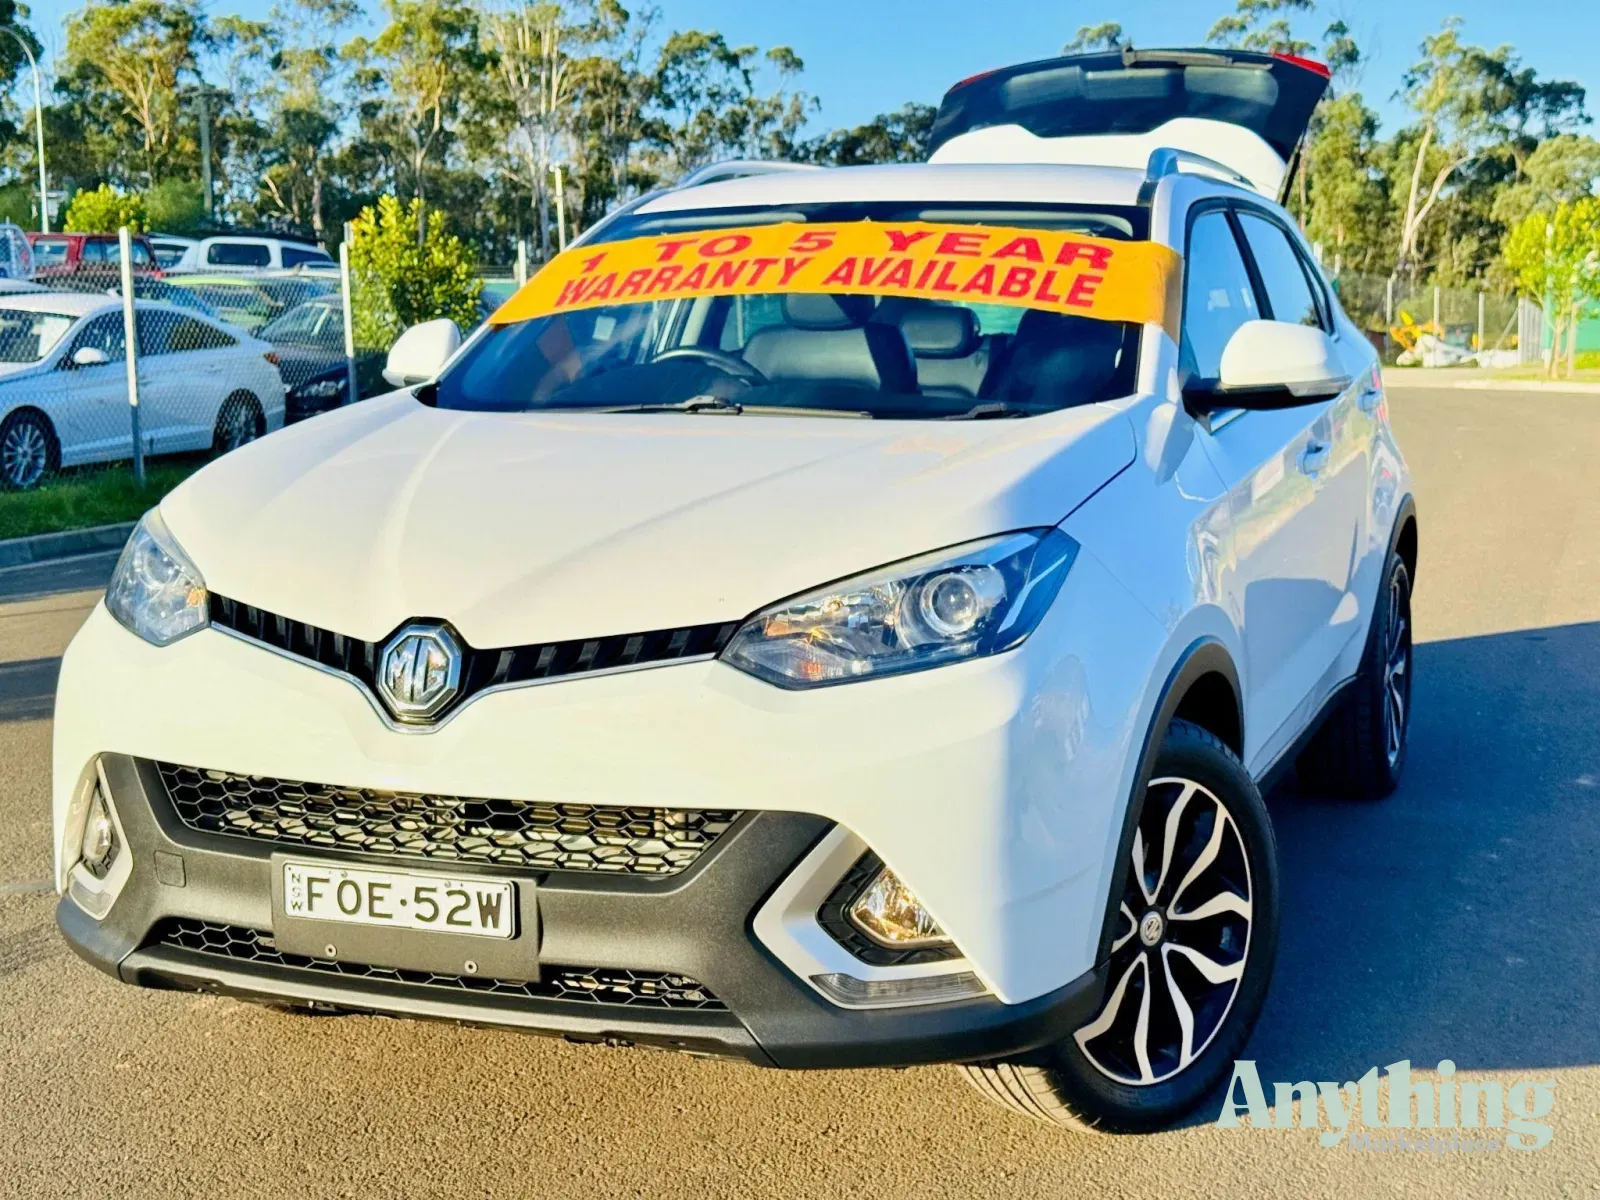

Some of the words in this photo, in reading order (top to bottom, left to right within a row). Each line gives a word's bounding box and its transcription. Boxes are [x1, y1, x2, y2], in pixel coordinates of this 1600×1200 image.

[580, 251, 609, 274] 1
[656, 234, 753, 263] TO
[788, 231, 837, 253] 5
[884, 230, 1115, 271] YEAR
[553, 256, 816, 308] WARRANTY
[820, 256, 1104, 308] AVAILABLE
[385, 636, 449, 706] MG
[291, 872, 304, 911] NSW
